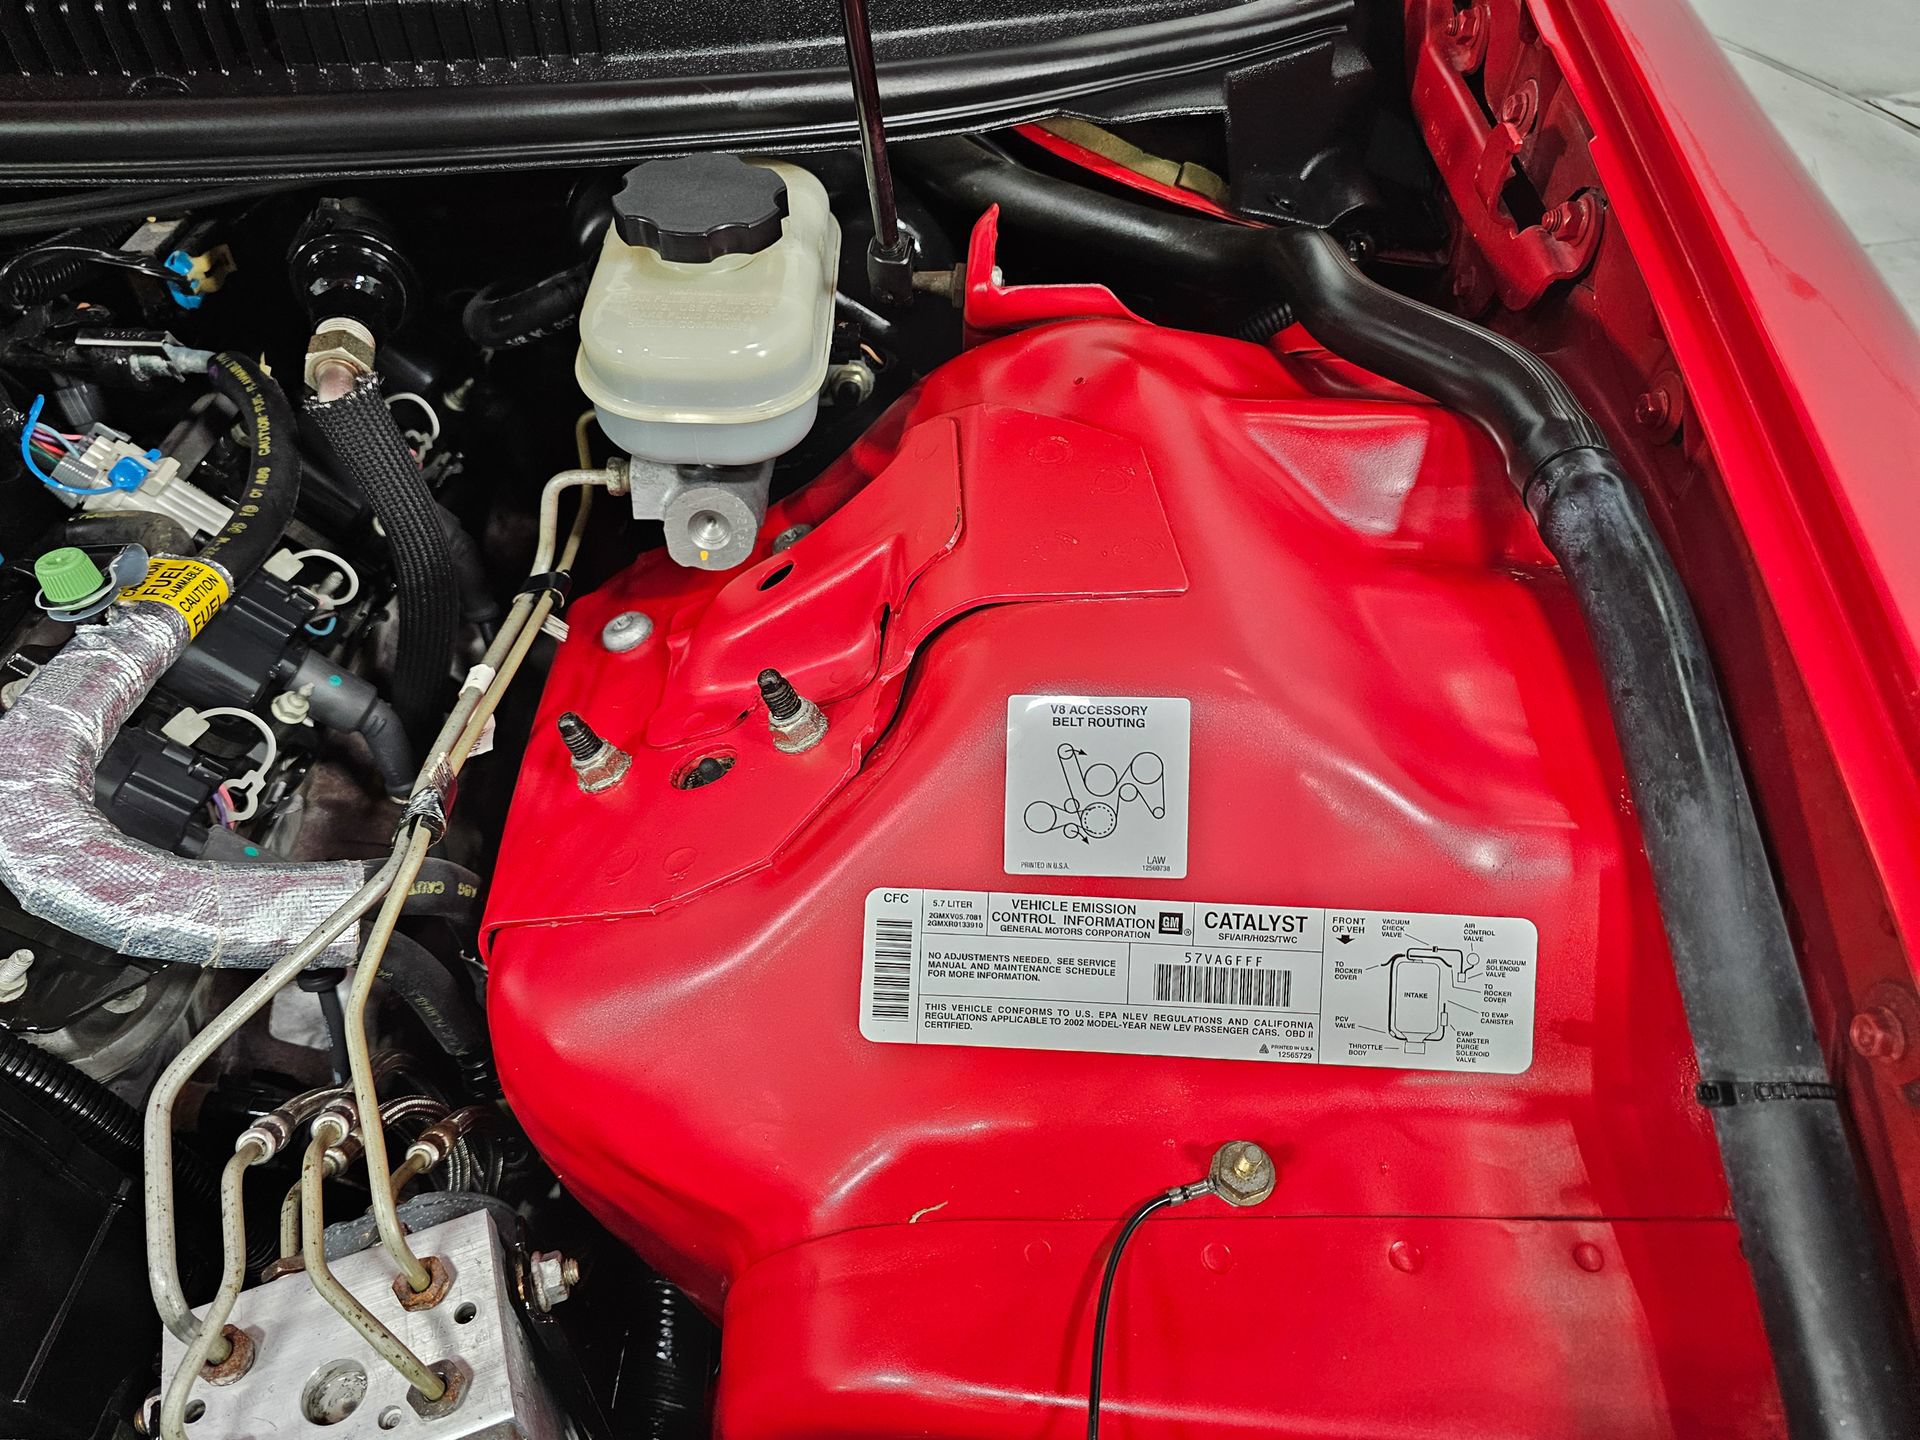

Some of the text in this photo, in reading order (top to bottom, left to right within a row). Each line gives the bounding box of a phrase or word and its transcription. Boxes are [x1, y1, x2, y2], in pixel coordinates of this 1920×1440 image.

[141, 564, 191, 596] FUEL
[162, 566, 205, 600] FLAMMABLE
[179, 574, 220, 612] CAUTION
[1050, 705, 1148, 715] V8 ACCESSORY
[1052, 717, 1146, 728] BELT ROUTING
[1146, 856, 1166, 864] LAW
[883, 893, 909, 903] CFC
[947, 901, 973, 909] LITER
[1012, 899, 1137, 915] VEHICLE EMISSION
[992, 912, 1156, 930] CONTROL INFORMATION
[1204, 911, 1309, 933] CATALYST
[1332, 916, 1366, 925] FRONT
[1000, 925, 1151, 939] GENERAL MOTORS CORPORATION
[1332, 925, 1366, 934] OF VEH
[943, 953, 1010, 962] ADJUSTMENTS
[1012, 955, 1052, 964] NEEDED.
[1077, 959, 1116, 967] SERVICE
[1185, 953, 1263, 966] 57VAGFFF
[928, 961, 967, 969] MANUAL
[993, 964, 1062, 973] MAINTENANCE
[1065, 967, 1116, 976] SCHEDULE
[976, 972, 1041, 981] INFORMATION.
[925, 1003, 947, 1011] THIS
[951, 1004, 993, 1013] VEHICLE
[997, 1006, 1053, 1016] CONFORMS
[1075, 1010, 1094, 1018] U.S.
[1122, 1013, 1149, 1021] NLEV
[1153, 1014, 1223, 1025] REGULATIONS
[1228, 1018, 1249, 1026] AND
[1253, 1019, 1314, 1029] CALIFORNIA
[924, 1012, 988, 1022] REGULATIONS
[990, 1015, 1048, 1024] APPLICABLE
[1049, 1017, 1062, 1025] TO
[1063, 1019, 1085, 1027] 2002
[1086, 1020, 1147, 1029] MODEL-YEAR
[1149, 1022, 1171, 1030] NEW
[1173, 1023, 1191, 1032] LEV
[1193, 1025, 1249, 1035] PASSENGER
[1251, 1028, 1280, 1037] CARS.
[924, 1021, 973, 1030] CERTIFIED.
[1278, 1051, 1312, 1059] 12565729
